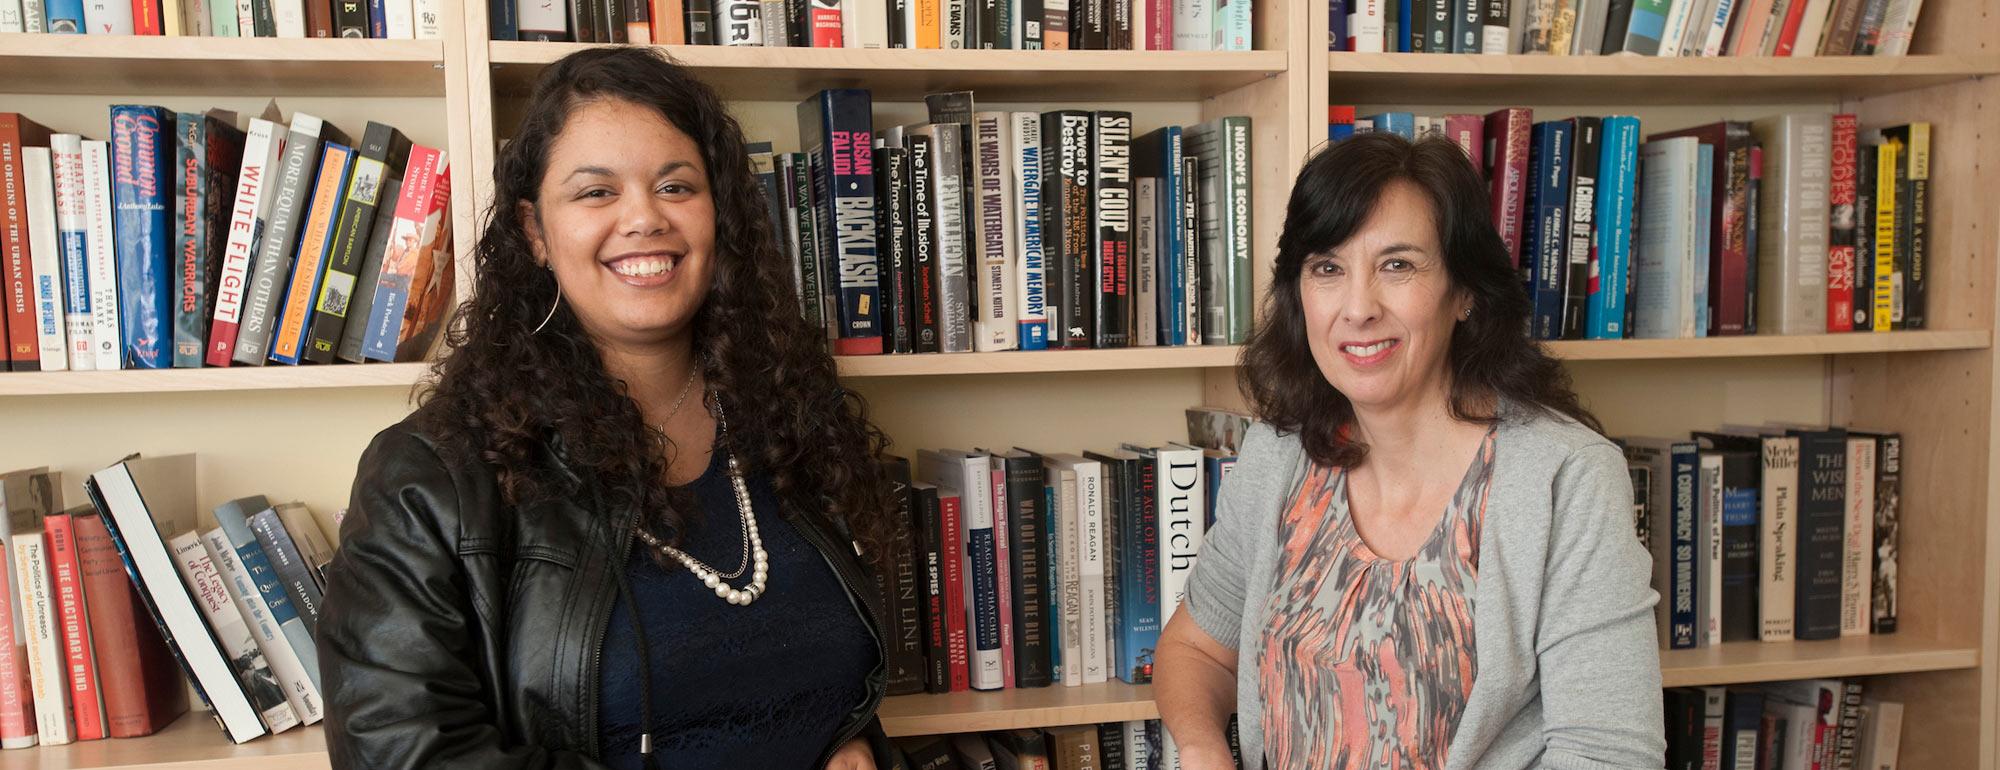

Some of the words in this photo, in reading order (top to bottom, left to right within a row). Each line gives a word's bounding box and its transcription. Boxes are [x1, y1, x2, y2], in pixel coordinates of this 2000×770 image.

[950, 4, 961, 36] EVANS
[979, 118, 998, 139] THE
[1022, 117, 1031, 144] SCHUDSON
[1030, 120, 1038, 142] MICHAEL
[1077, 116, 1089, 165] Power
[2, 142, 11, 161] THE
[115, 115, 139, 184] Ground
[137, 115, 157, 197] Common
[369, 144, 381, 152] SELF
[832, 131, 852, 175] FALUDI
[852, 132, 872, 175] SUSAN
[914, 142, 927, 168] The
[980, 140, 1000, 176] WARS
[1060, 115, 1077, 177] Destroy
[1100, 117, 1130, 182] SILENT
[1173, 134, 1181, 176] WATERGATE
[1235, 126, 1247, 185] NIXON'S
[1800, 125, 1823, 177] RACING
[1831, 117, 1846, 205] RHODES
[1844, 117, 1857, 205] RICHARD
[283, 142, 306, 185] MORE
[420, 154, 436, 192] BEFORE
[796, 160, 805, 183] THE
[890, 155, 901, 179] The
[1022, 147, 1040, 205] WATERGATE
[1077, 169, 1089, 186] to
[5, 164, 17, 205] ORIGINS
[183, 159, 197, 234] SUBURBAN
[406, 167, 421, 198] STORM
[891, 180, 901, 209] Time
[916, 168, 928, 199] Time
[982, 178, 1001, 192] OF
[1064, 178, 1072, 213] Kennedy
[1073, 185, 1080, 196] of
[1505, 167, 1520, 212] AROUND
[1578, 176, 1594, 185] A
[1800, 184, 1822, 209] FOR
[234, 166, 260, 230] WHITE
[272, 187, 296, 235] EQUAL
[414, 195, 425, 214] THE
[798, 185, 809, 209] WAY
[917, 200, 930, 217] of
[1024, 207, 1039, 218] IN
[1100, 187, 1129, 232] COUP
[1575, 186, 1593, 222] CROSS
[1914, 181, 1924, 223] UNDER
[8, 208, 18, 221] OF
[348, 207, 362, 236] AMERICAN
[800, 210, 810, 229] WE
[892, 212, 902, 226] of
[940, 176, 963, 278] NIGHTMARE
[983, 193, 1004, 258] WATERGATE
[1065, 217, 1072, 226] to
[1235, 189, 1248, 259] ECONOMY
[1505, 215, 1516, 235] THE
[1574, 223, 1590, 236] OF
[1800, 215, 1822, 239] THE
[10, 223, 20, 243] THE
[835, 197, 879, 288] BACKLASH
[919, 218, 932, 262] Illusion
[1024, 219, 1043, 269] AMERICAN
[1914, 227, 1922, 235] A
[11, 246, 22, 278] URBAN
[263, 237, 285, 273] THAN
[342, 238, 355, 266] BABYLON
[801, 232, 813, 270] NEVER
[892, 227, 904, 268] Illusion
[1103, 240, 1114, 265] ROBERT
[1571, 237, 1589, 264] IRON
[1912, 239, 1922, 281] CLOUD
[183, 240, 197, 312] WARRIORS
[219, 242, 248, 319] FLIGHT
[1103, 267, 1114, 292] GETTLIN
[1799, 245, 1821, 286] BOMB
[1828, 249, 1843, 289] SUN
[1842, 246, 1855, 291] DARK
[14, 281, 25, 313] CRISIS
[40, 275, 54, 299] RICHARD
[806, 272, 816, 304] WERE
[920, 266, 930, 300] Jonathan
[1026, 272, 1044, 316] MEMORY
[42, 301, 56, 335] HOFSTADTER
[95, 291, 105, 326] FRANK
[105, 289, 115, 329] THOMAS
[248, 278, 273, 333] OTHERS
[923, 302, 933, 324] Schell
[851, 320, 872, 328] CROWN
[1677, 463, 1692, 472] A
[1764, 457, 1798, 469] Miller
[1766, 446, 1797, 457] Merle
[1886, 439, 1899, 472] POLIO
[1142, 464, 1153, 492] THE
[1712, 466, 1720, 484] The
[1019, 500, 1035, 520] WAY
[1087, 476, 1096, 517] RONALD
[1142, 495, 1154, 523] AGE
[1677, 474, 1692, 541] CONSPIRACY
[1711, 487, 1720, 523] Politics
[1775, 486, 1787, 519] Plain
[946, 503, 956, 541] ARSENALS
[1169, 459, 1198, 572] Dutch
[1711, 526, 1721, 536] of
[54, 528, 65, 552] ROBIN
[948, 545, 956, 555] OF
[1020, 524, 1036, 544] OUT
[1088, 521, 1097, 562] REAGAN
[1143, 526, 1154, 545] OF
[1711, 539, 1720, 560] Fear
[29, 544, 38, 559] The
[188, 560, 201, 571] of
[200, 554, 216, 575] The
[928, 551, 938, 564] IN
[1022, 548, 1037, 580] THERE
[1677, 545, 1692, 561] SO
[1772, 522, 1786, 582] Speaking
[31, 560, 44, 589] Politics
[57, 562, 71, 583] THE
[896, 551, 915, 601] THIN
[928, 565, 940, 595] SPIES
[949, 559, 957, 582] FOLLY
[1144, 549, 1156, 605] REAGAN
[36, 590, 46, 599] of
[192, 571, 222, 613] Conquest
[204, 570, 229, 606] Legacy
[1023, 584, 1037, 595] IN
[1065, 580, 1079, 615] REAGAN
[1677, 562, 1692, 613] IMMENSE
[37, 601, 48, 640] Unreason
[930, 596, 940, 613] WE
[1024, 600, 1038, 618] THE
[61, 587, 83, 660] REACTIONARY
[901, 607, 919, 651] LINE
[931, 614, 943, 648] TRUST
[1025, 622, 1040, 647] BLUE
[0, 624, 16, 682] YANKEE
[948, 632, 958, 664] RHODES
[956, 629, 966, 665] RICHARD
[1088, 632, 1096, 659] DIGGINS
[72, 665, 87, 691] MIND
[4, 683, 17, 708] SPY
